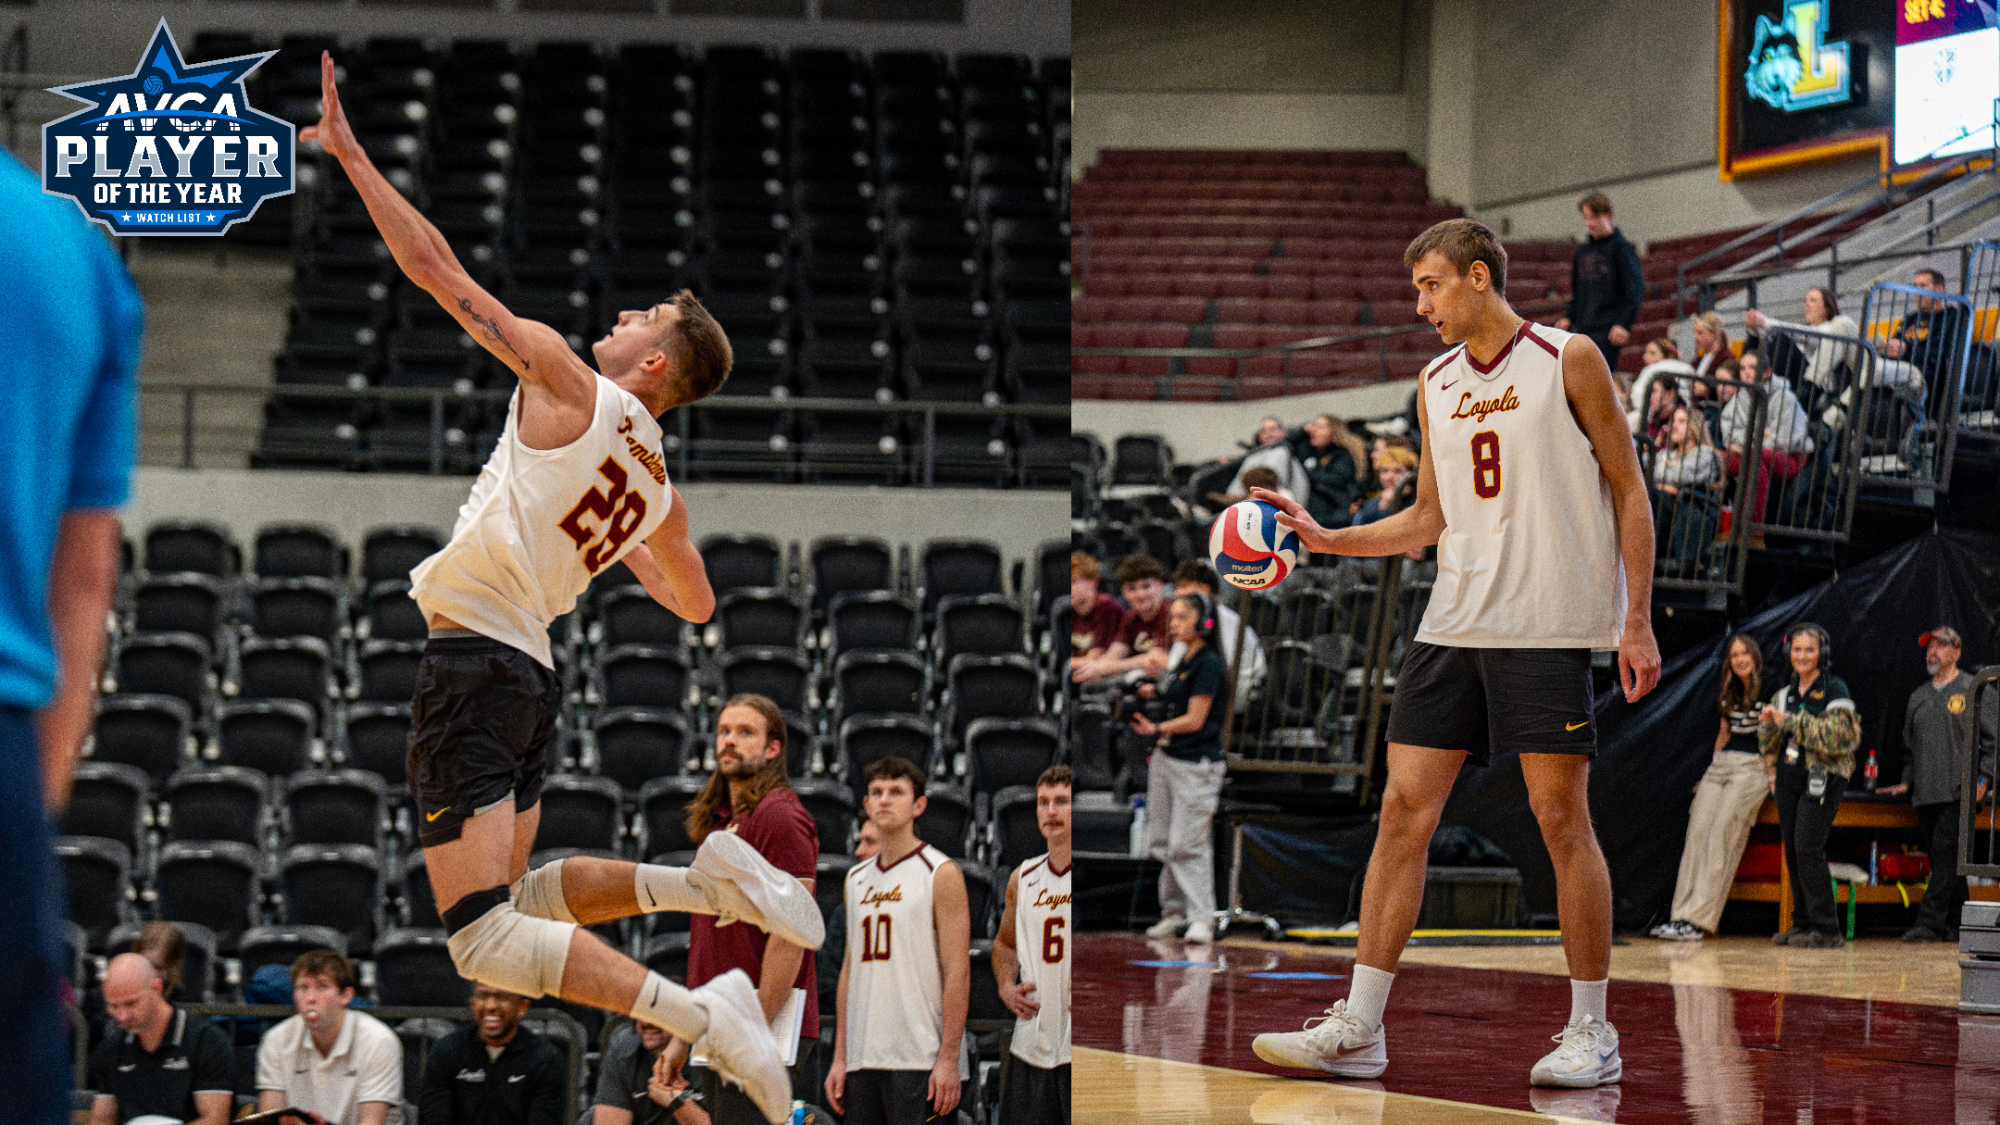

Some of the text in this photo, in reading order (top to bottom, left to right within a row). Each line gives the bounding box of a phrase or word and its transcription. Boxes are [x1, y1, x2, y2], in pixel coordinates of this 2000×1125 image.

[1450, 384, 1520, 423] Loyola
[1470, 429, 1502, 500] 8
[557, 453, 648, 577] 28
[1231, 564, 1263, 572] molten
[1232, 576, 1266, 585] NCAA
[859, 884, 903, 908] Loyola
[861, 913, 893, 963] 10
[1042, 915, 1066, 964] 6
